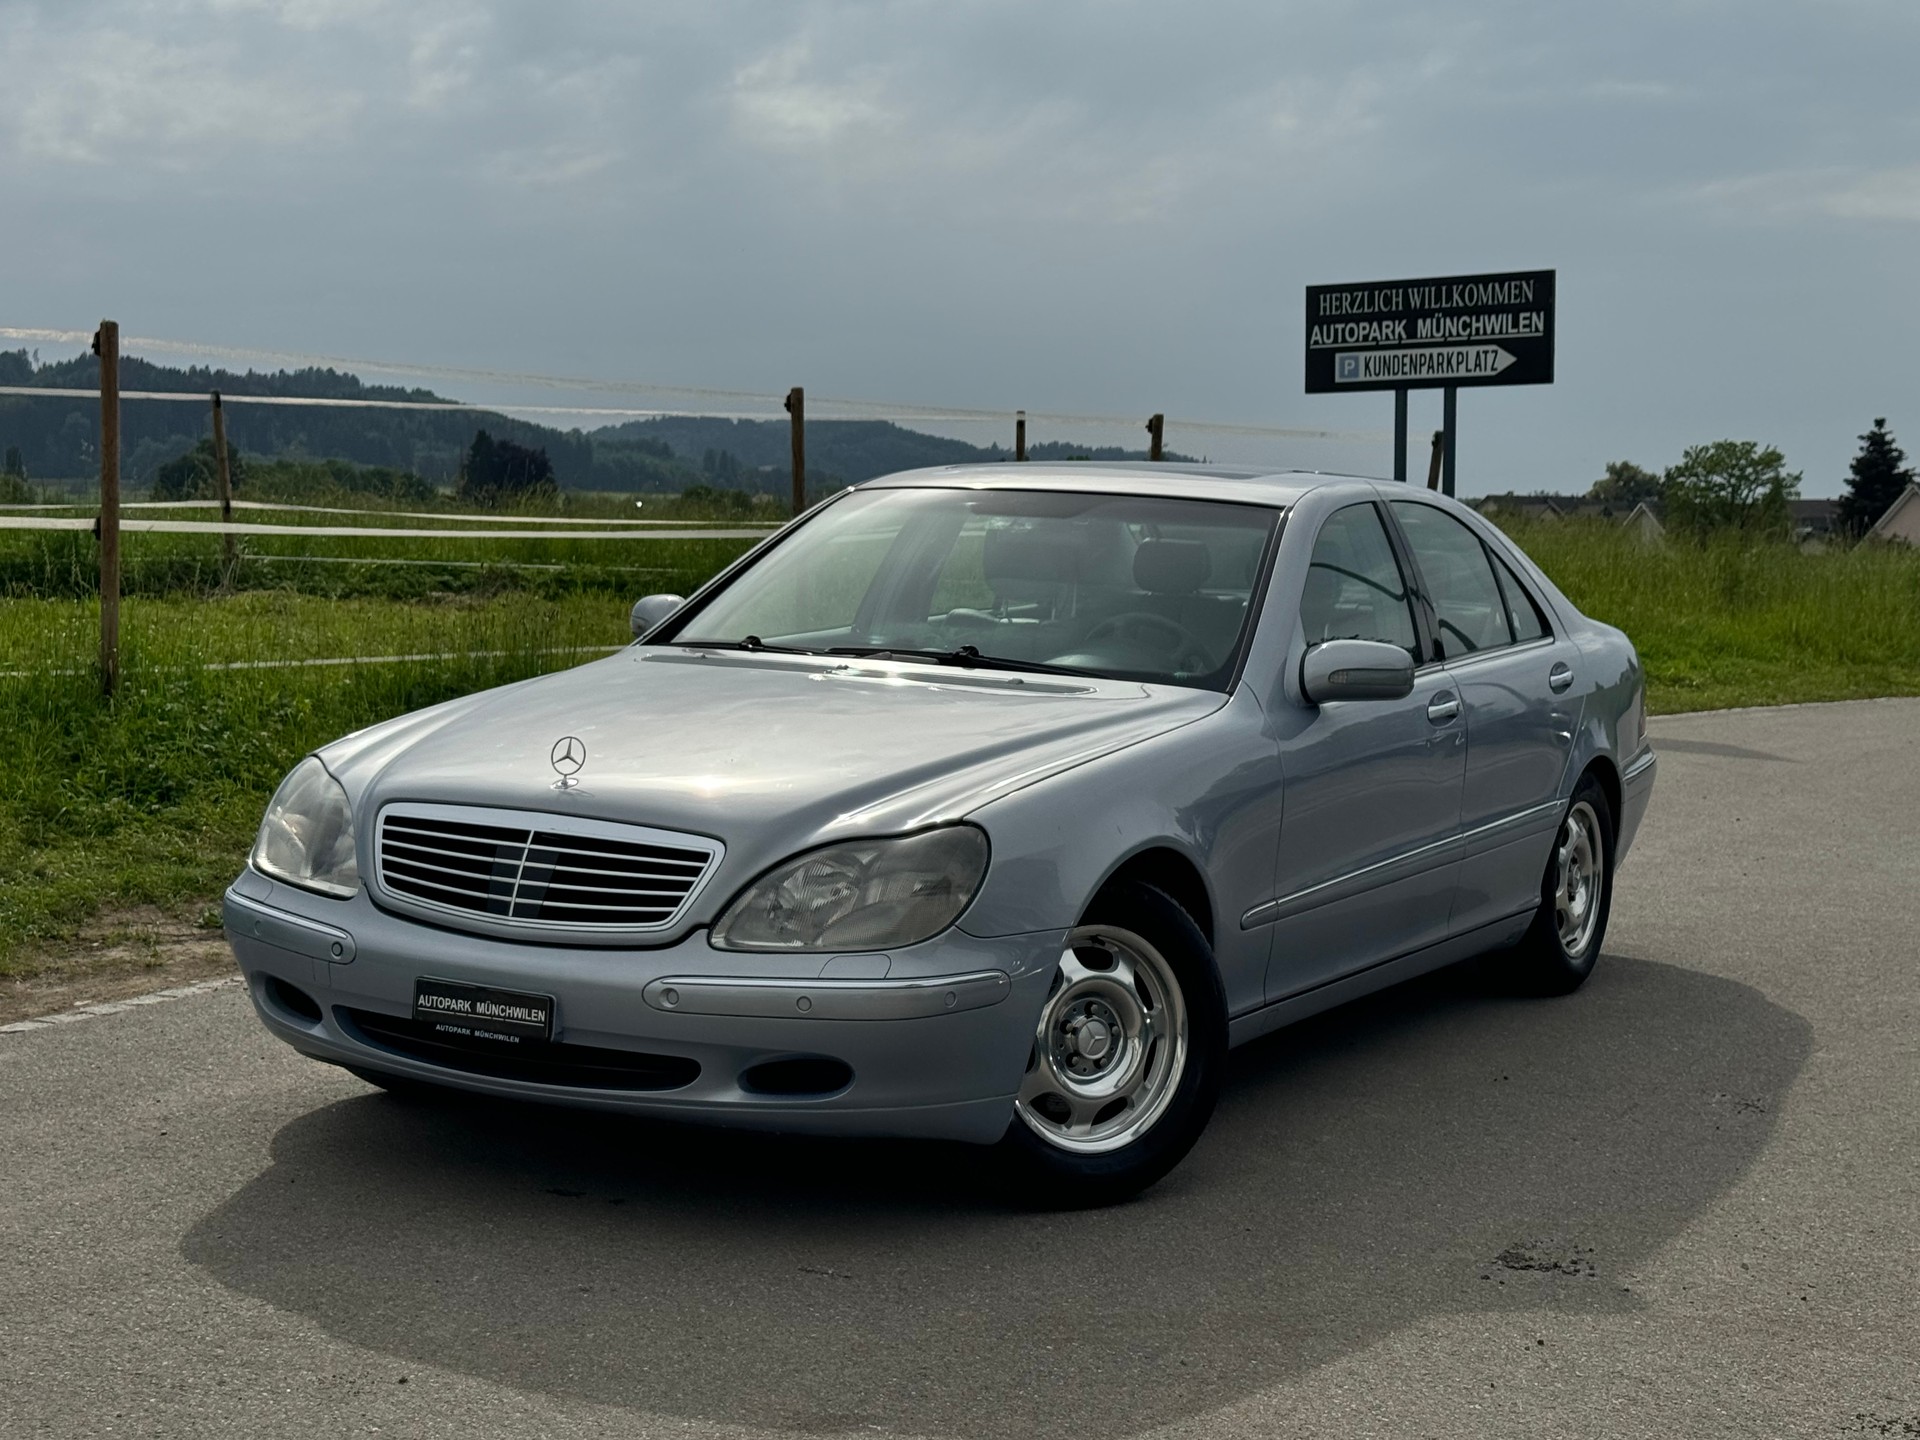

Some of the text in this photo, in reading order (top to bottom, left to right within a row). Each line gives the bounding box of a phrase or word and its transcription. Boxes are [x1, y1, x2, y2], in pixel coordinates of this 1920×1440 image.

[1319, 280, 1535, 316] HERZLICH WILLKOMMEN
[1310, 311, 1545, 344] AUTOPARK MÜNCHWILEN
[1344, 350, 1499, 378] P KUNDENPARKPLATZ
[418, 994, 545, 1022] AUTOPARK MÜNCHWILEN
[435, 1024, 520, 1043] AUTOPARK MÜNCHWILEN
